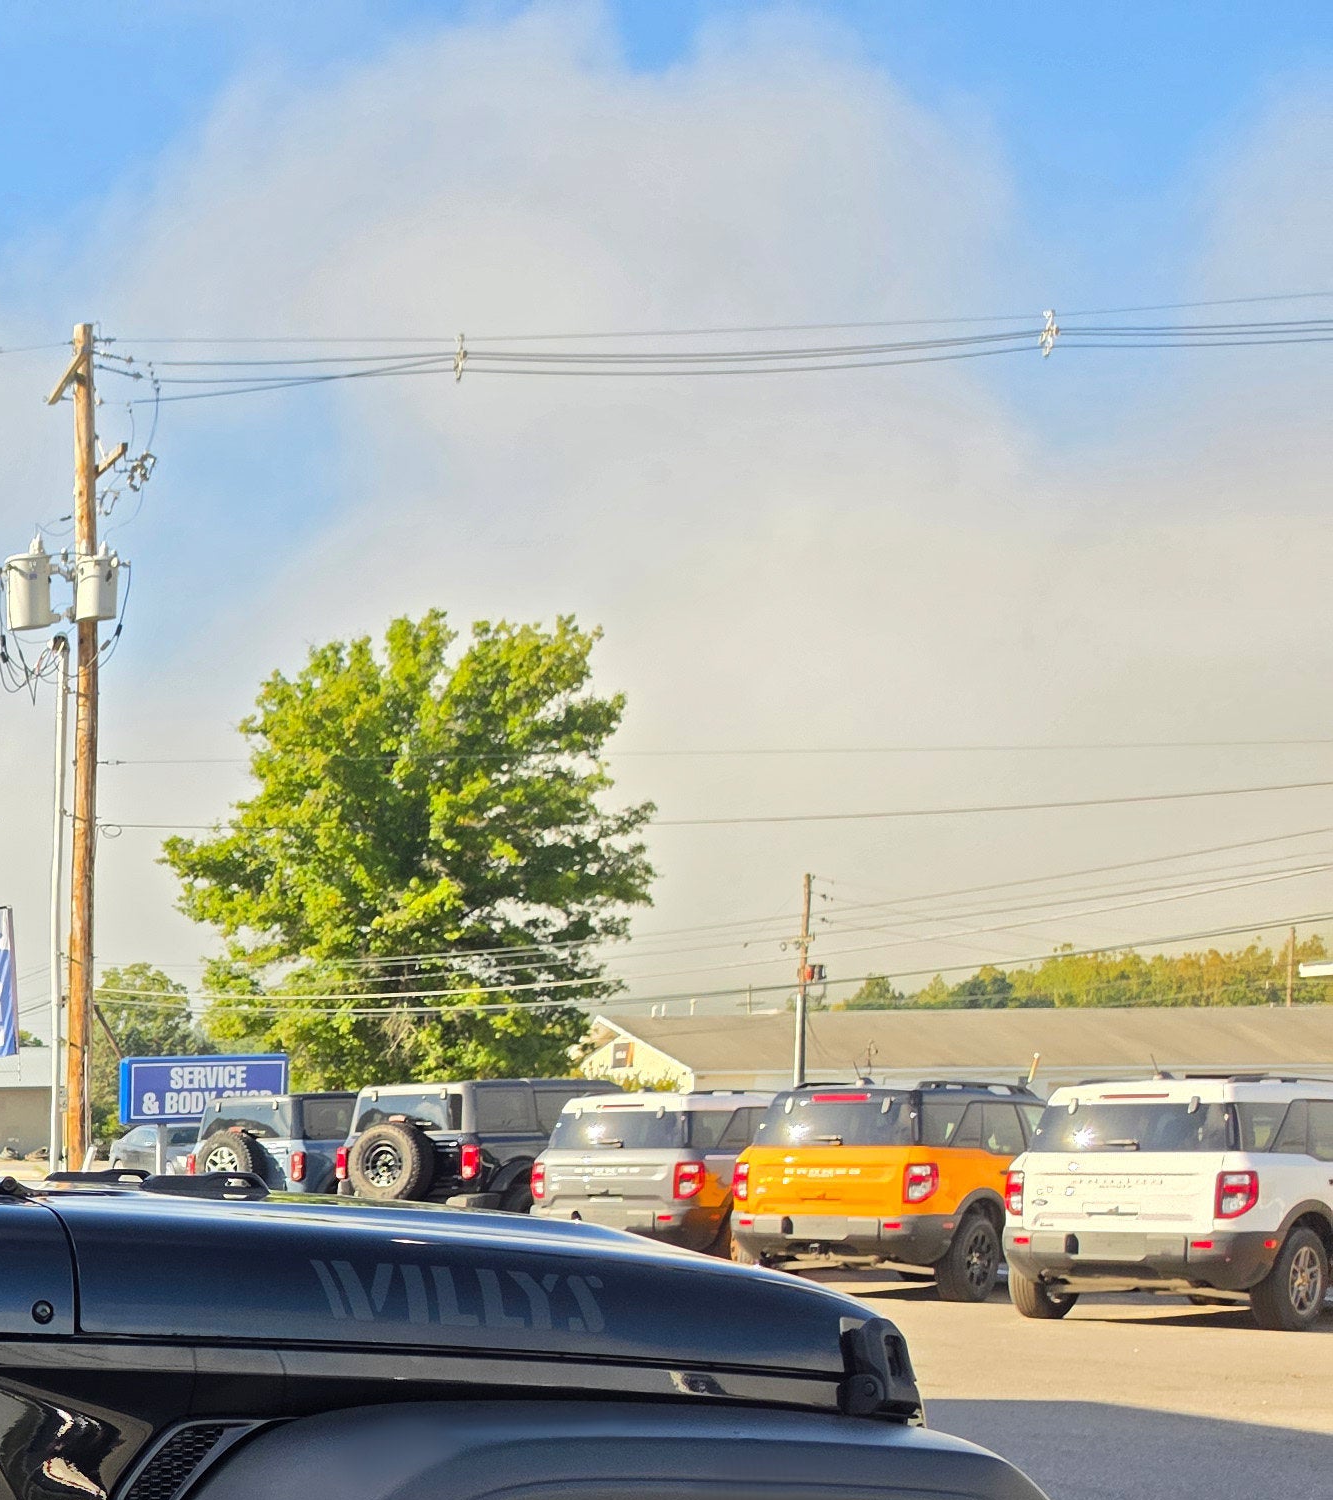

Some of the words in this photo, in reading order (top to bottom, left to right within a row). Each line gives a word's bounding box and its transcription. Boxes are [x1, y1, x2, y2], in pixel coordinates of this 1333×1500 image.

[170, 1065, 247, 1089] SERVICE
[142, 1092, 160, 1115] &
[309, 1258, 605, 1333] WILLYS
